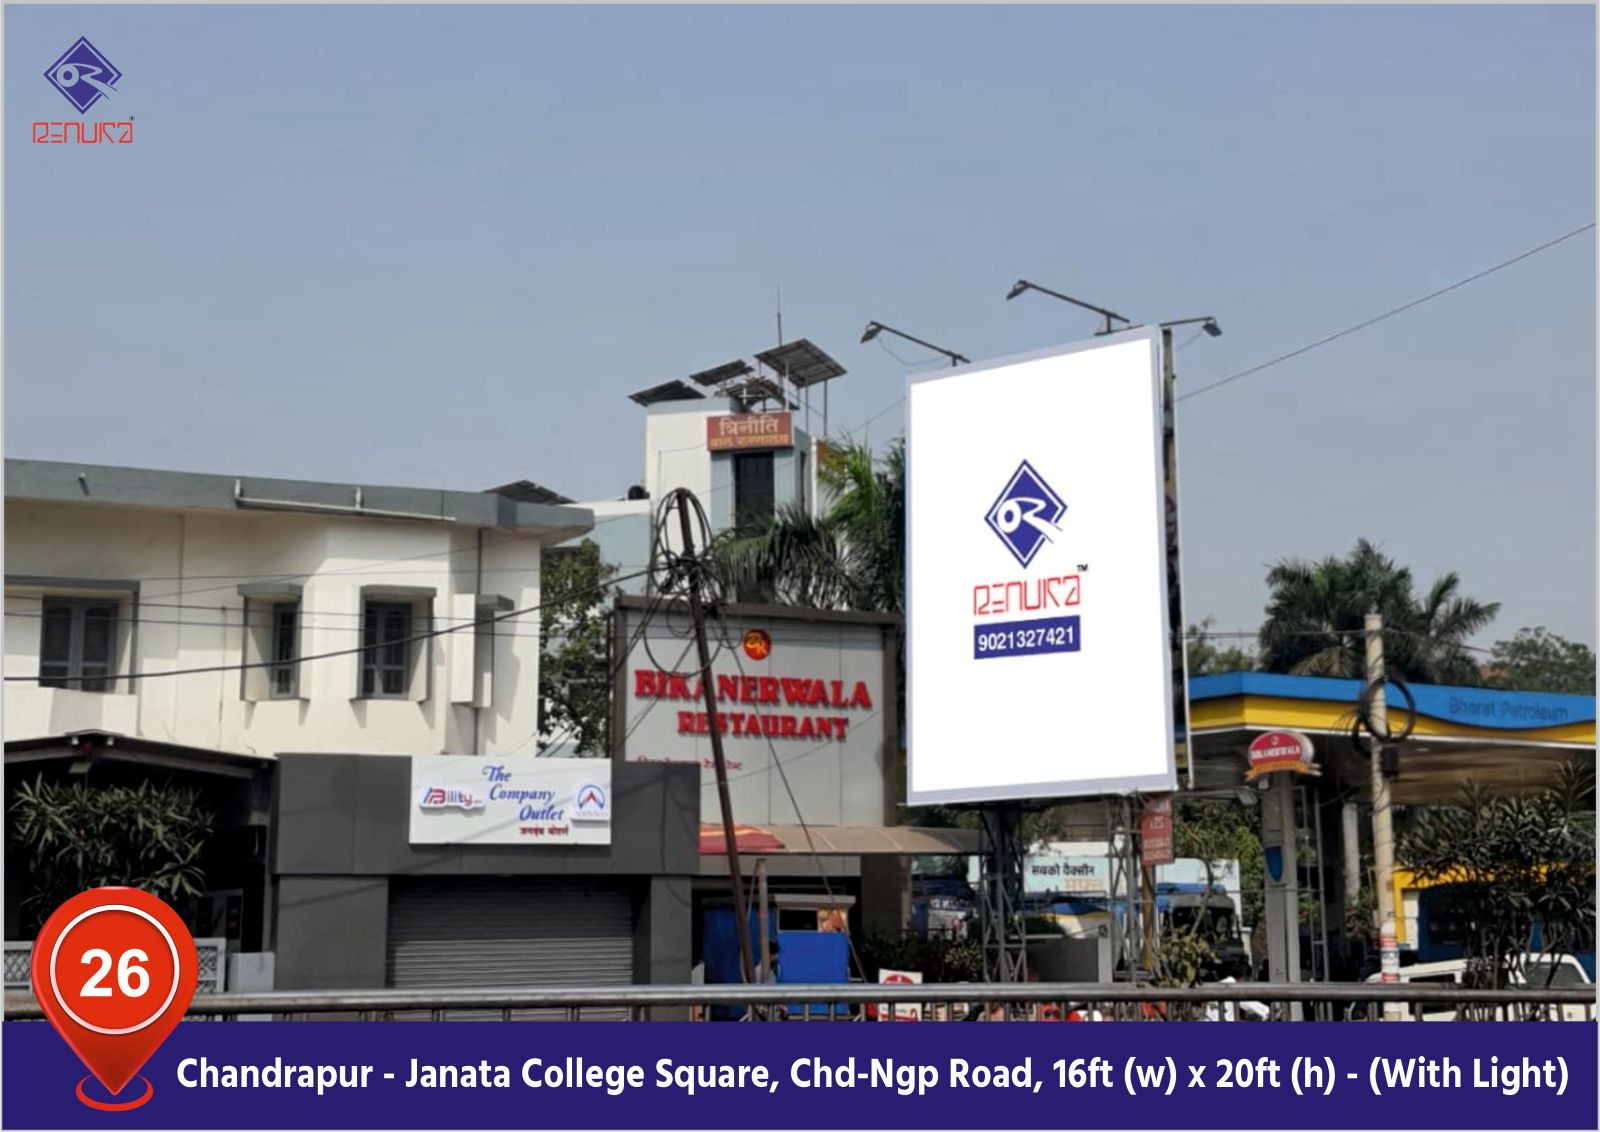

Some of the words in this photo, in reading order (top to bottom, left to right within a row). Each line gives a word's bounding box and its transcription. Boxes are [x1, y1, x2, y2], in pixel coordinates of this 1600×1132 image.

[978, 626, 1075, 652] 9021327421
[1449, 697, 1496, 717] Bharat
[1502, 701, 1568, 720] Petroleum
[482, 765, 511, 782] The
[489, 784, 555, 804] Company
[519, 805, 564, 822] Outlet
